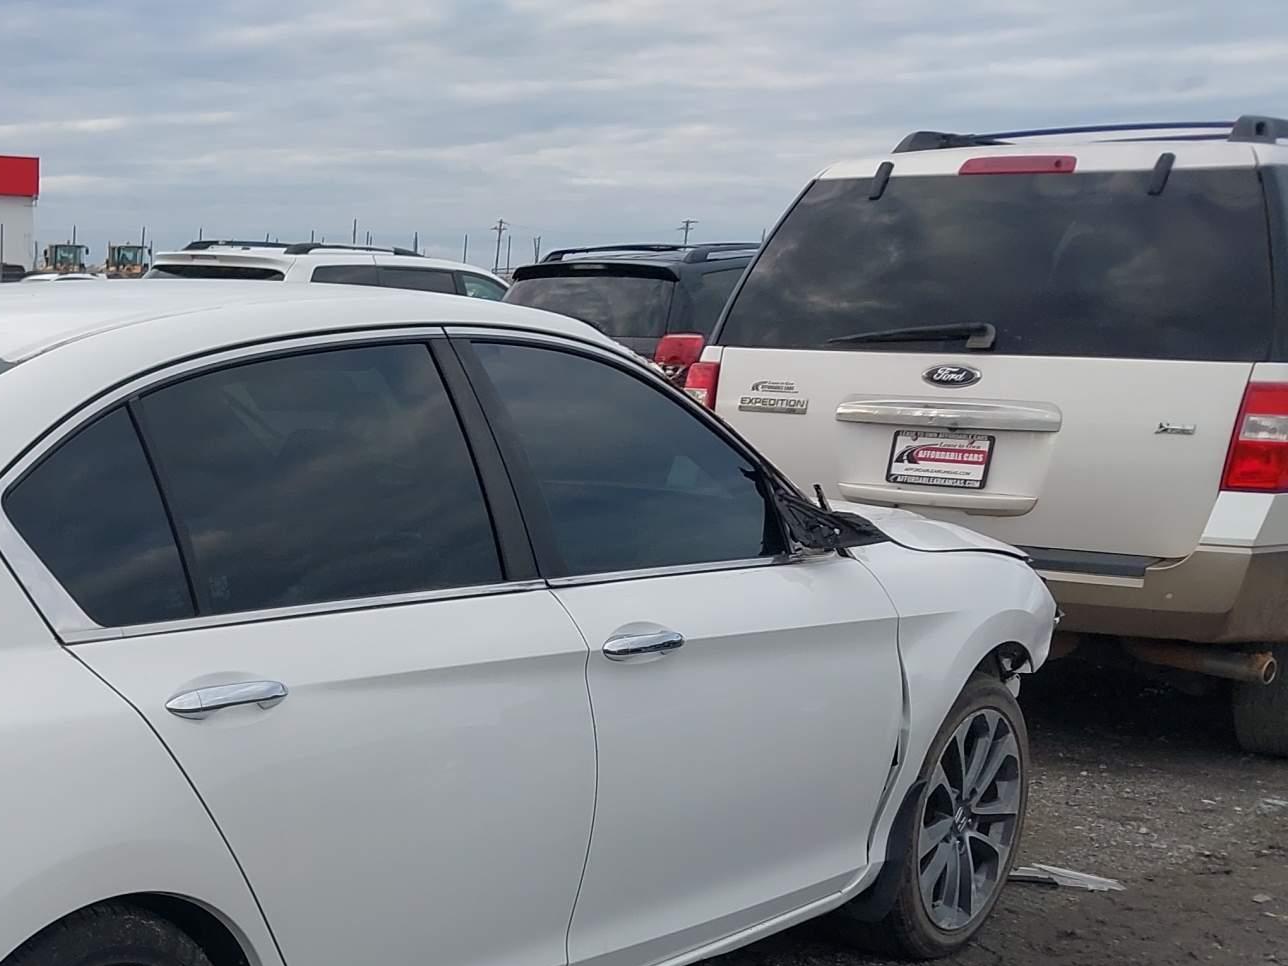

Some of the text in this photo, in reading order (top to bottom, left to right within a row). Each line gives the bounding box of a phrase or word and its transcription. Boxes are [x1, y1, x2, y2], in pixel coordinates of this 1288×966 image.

[933, 367, 967, 381] Ford
[740, 397, 805, 408] EXPEDITION
[917, 450, 984, 462] AFFORDABLE CARS
